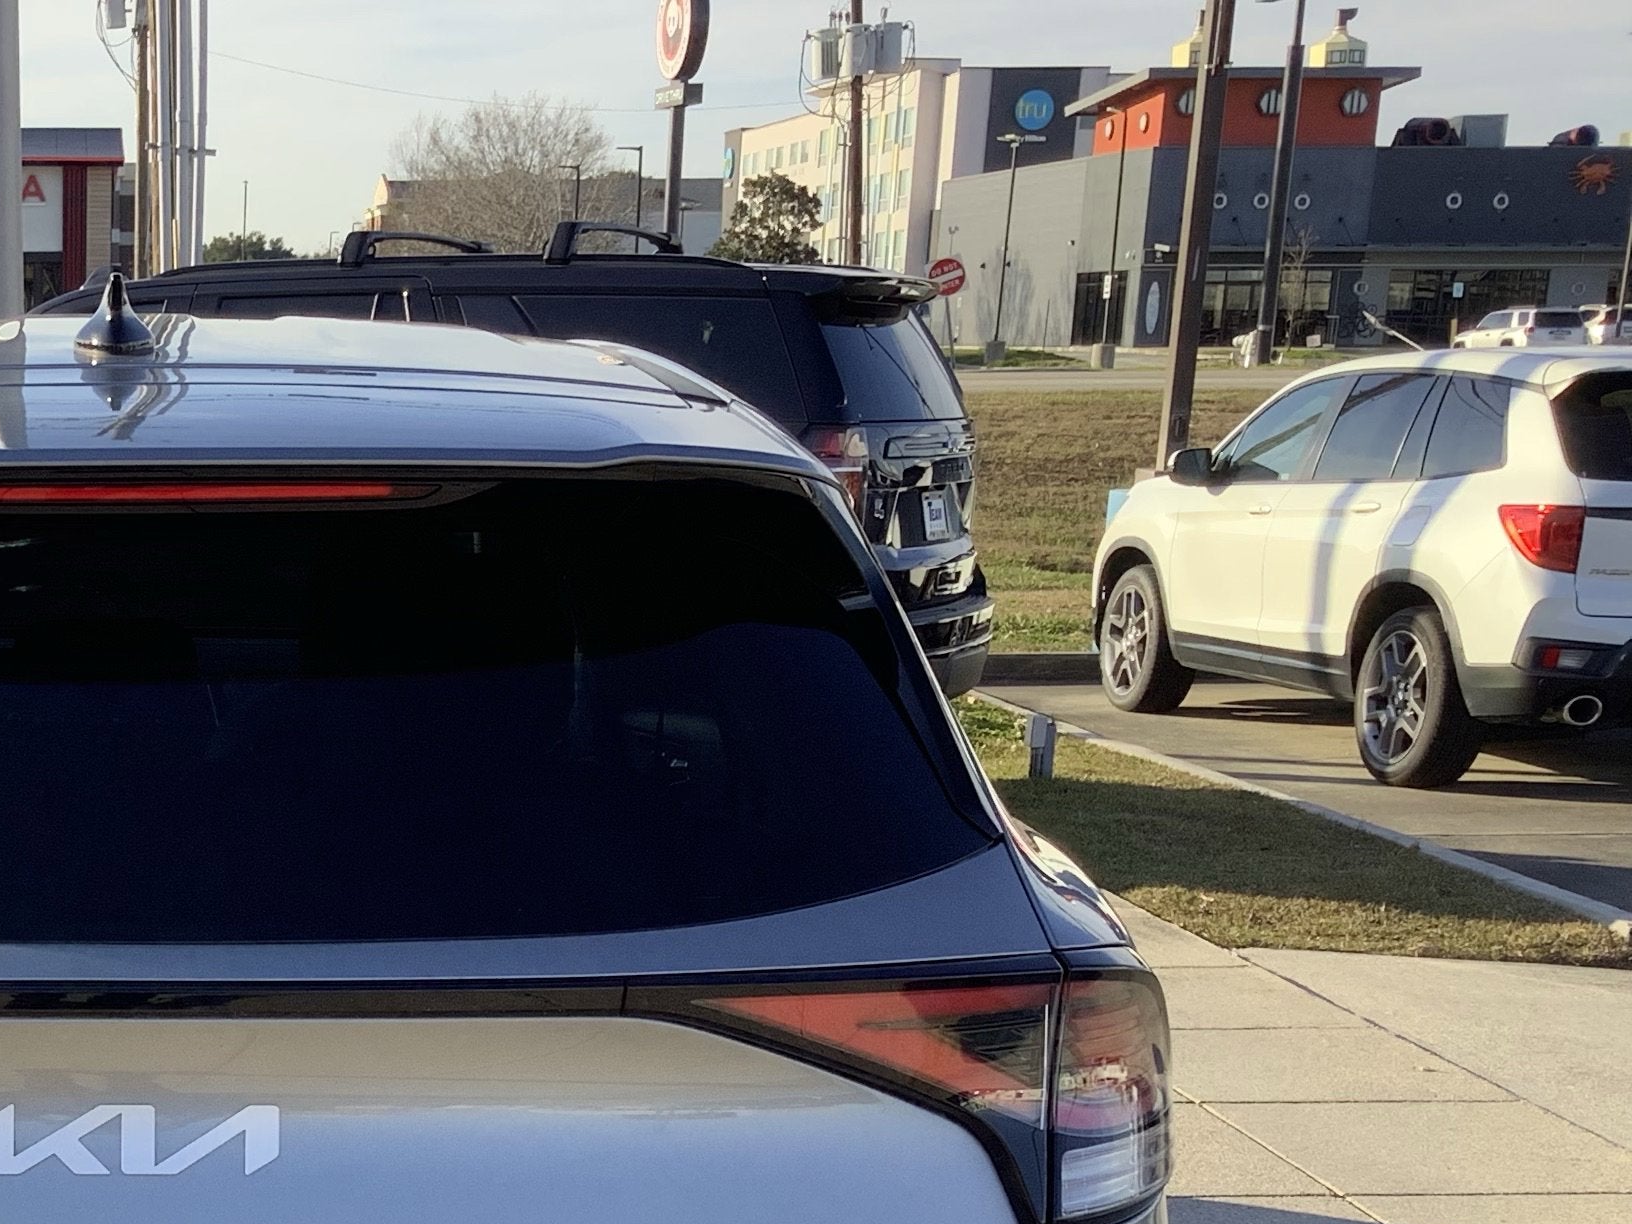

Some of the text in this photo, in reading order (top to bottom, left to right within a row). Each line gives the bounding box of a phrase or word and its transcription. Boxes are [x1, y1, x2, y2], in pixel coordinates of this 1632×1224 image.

[1017, 98, 1047, 119] tru
[931, 261, 958, 278] DO NOT
